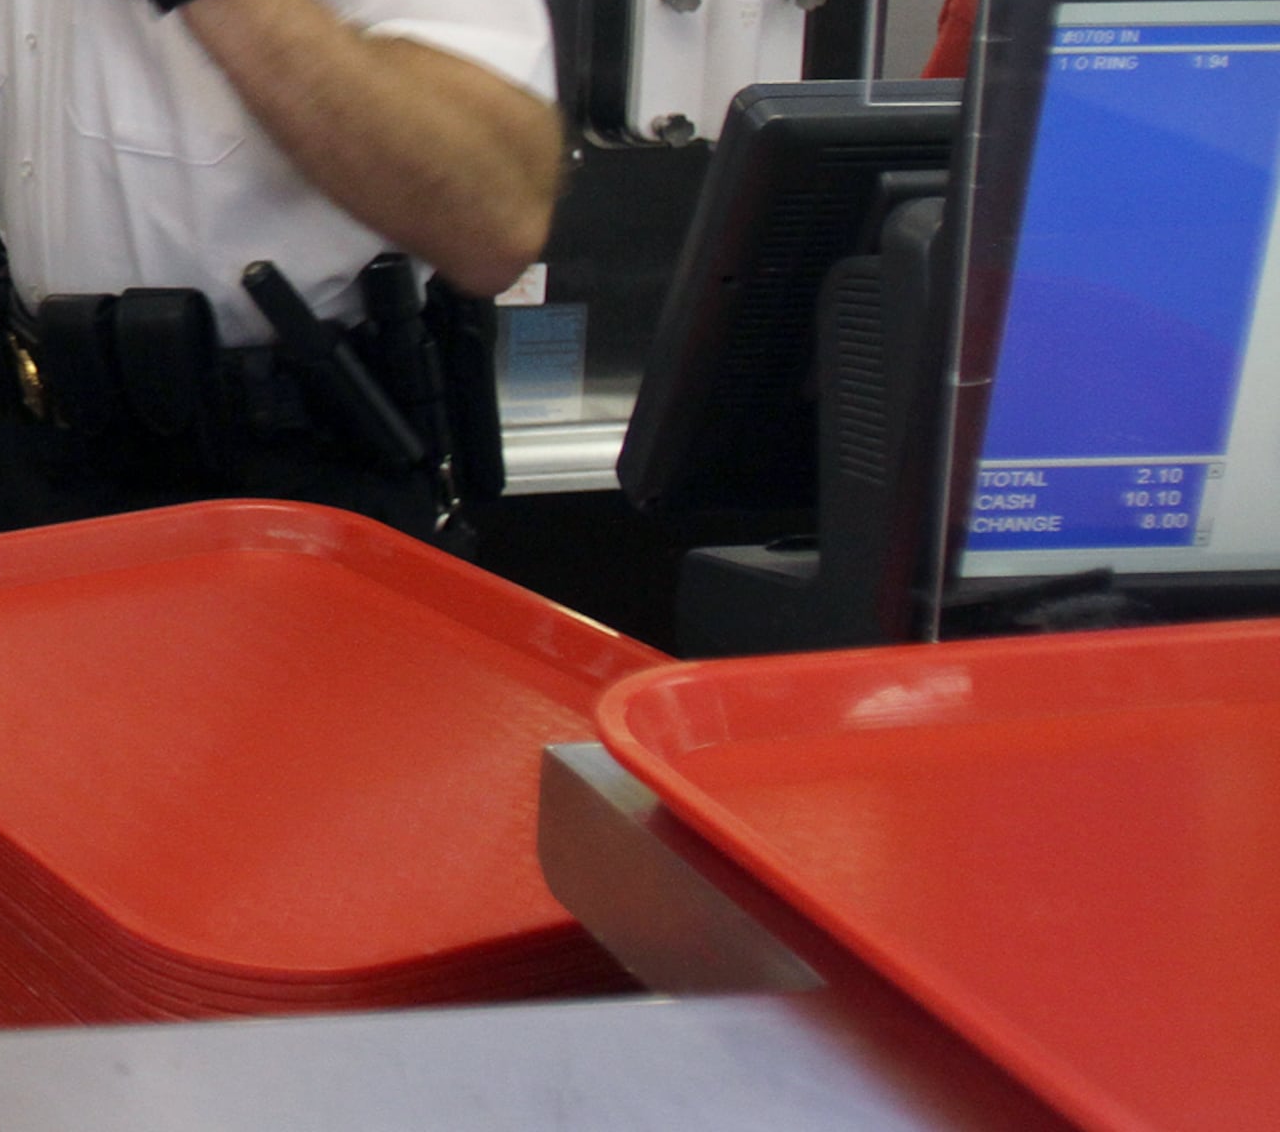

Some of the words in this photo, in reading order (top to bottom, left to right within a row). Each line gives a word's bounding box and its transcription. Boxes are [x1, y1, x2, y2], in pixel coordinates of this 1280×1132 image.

[1093, 55, 1140, 70] RING
[980, 471, 1048, 488] TOTAL
[1137, 468, 1184, 485] 2.10
[976, 494, 1037, 510] CASH
[1124, 490, 1182, 508] 10.10
[972, 515, 1065, 533] CHANGE
[1141, 513, 1190, 530] 8.00
